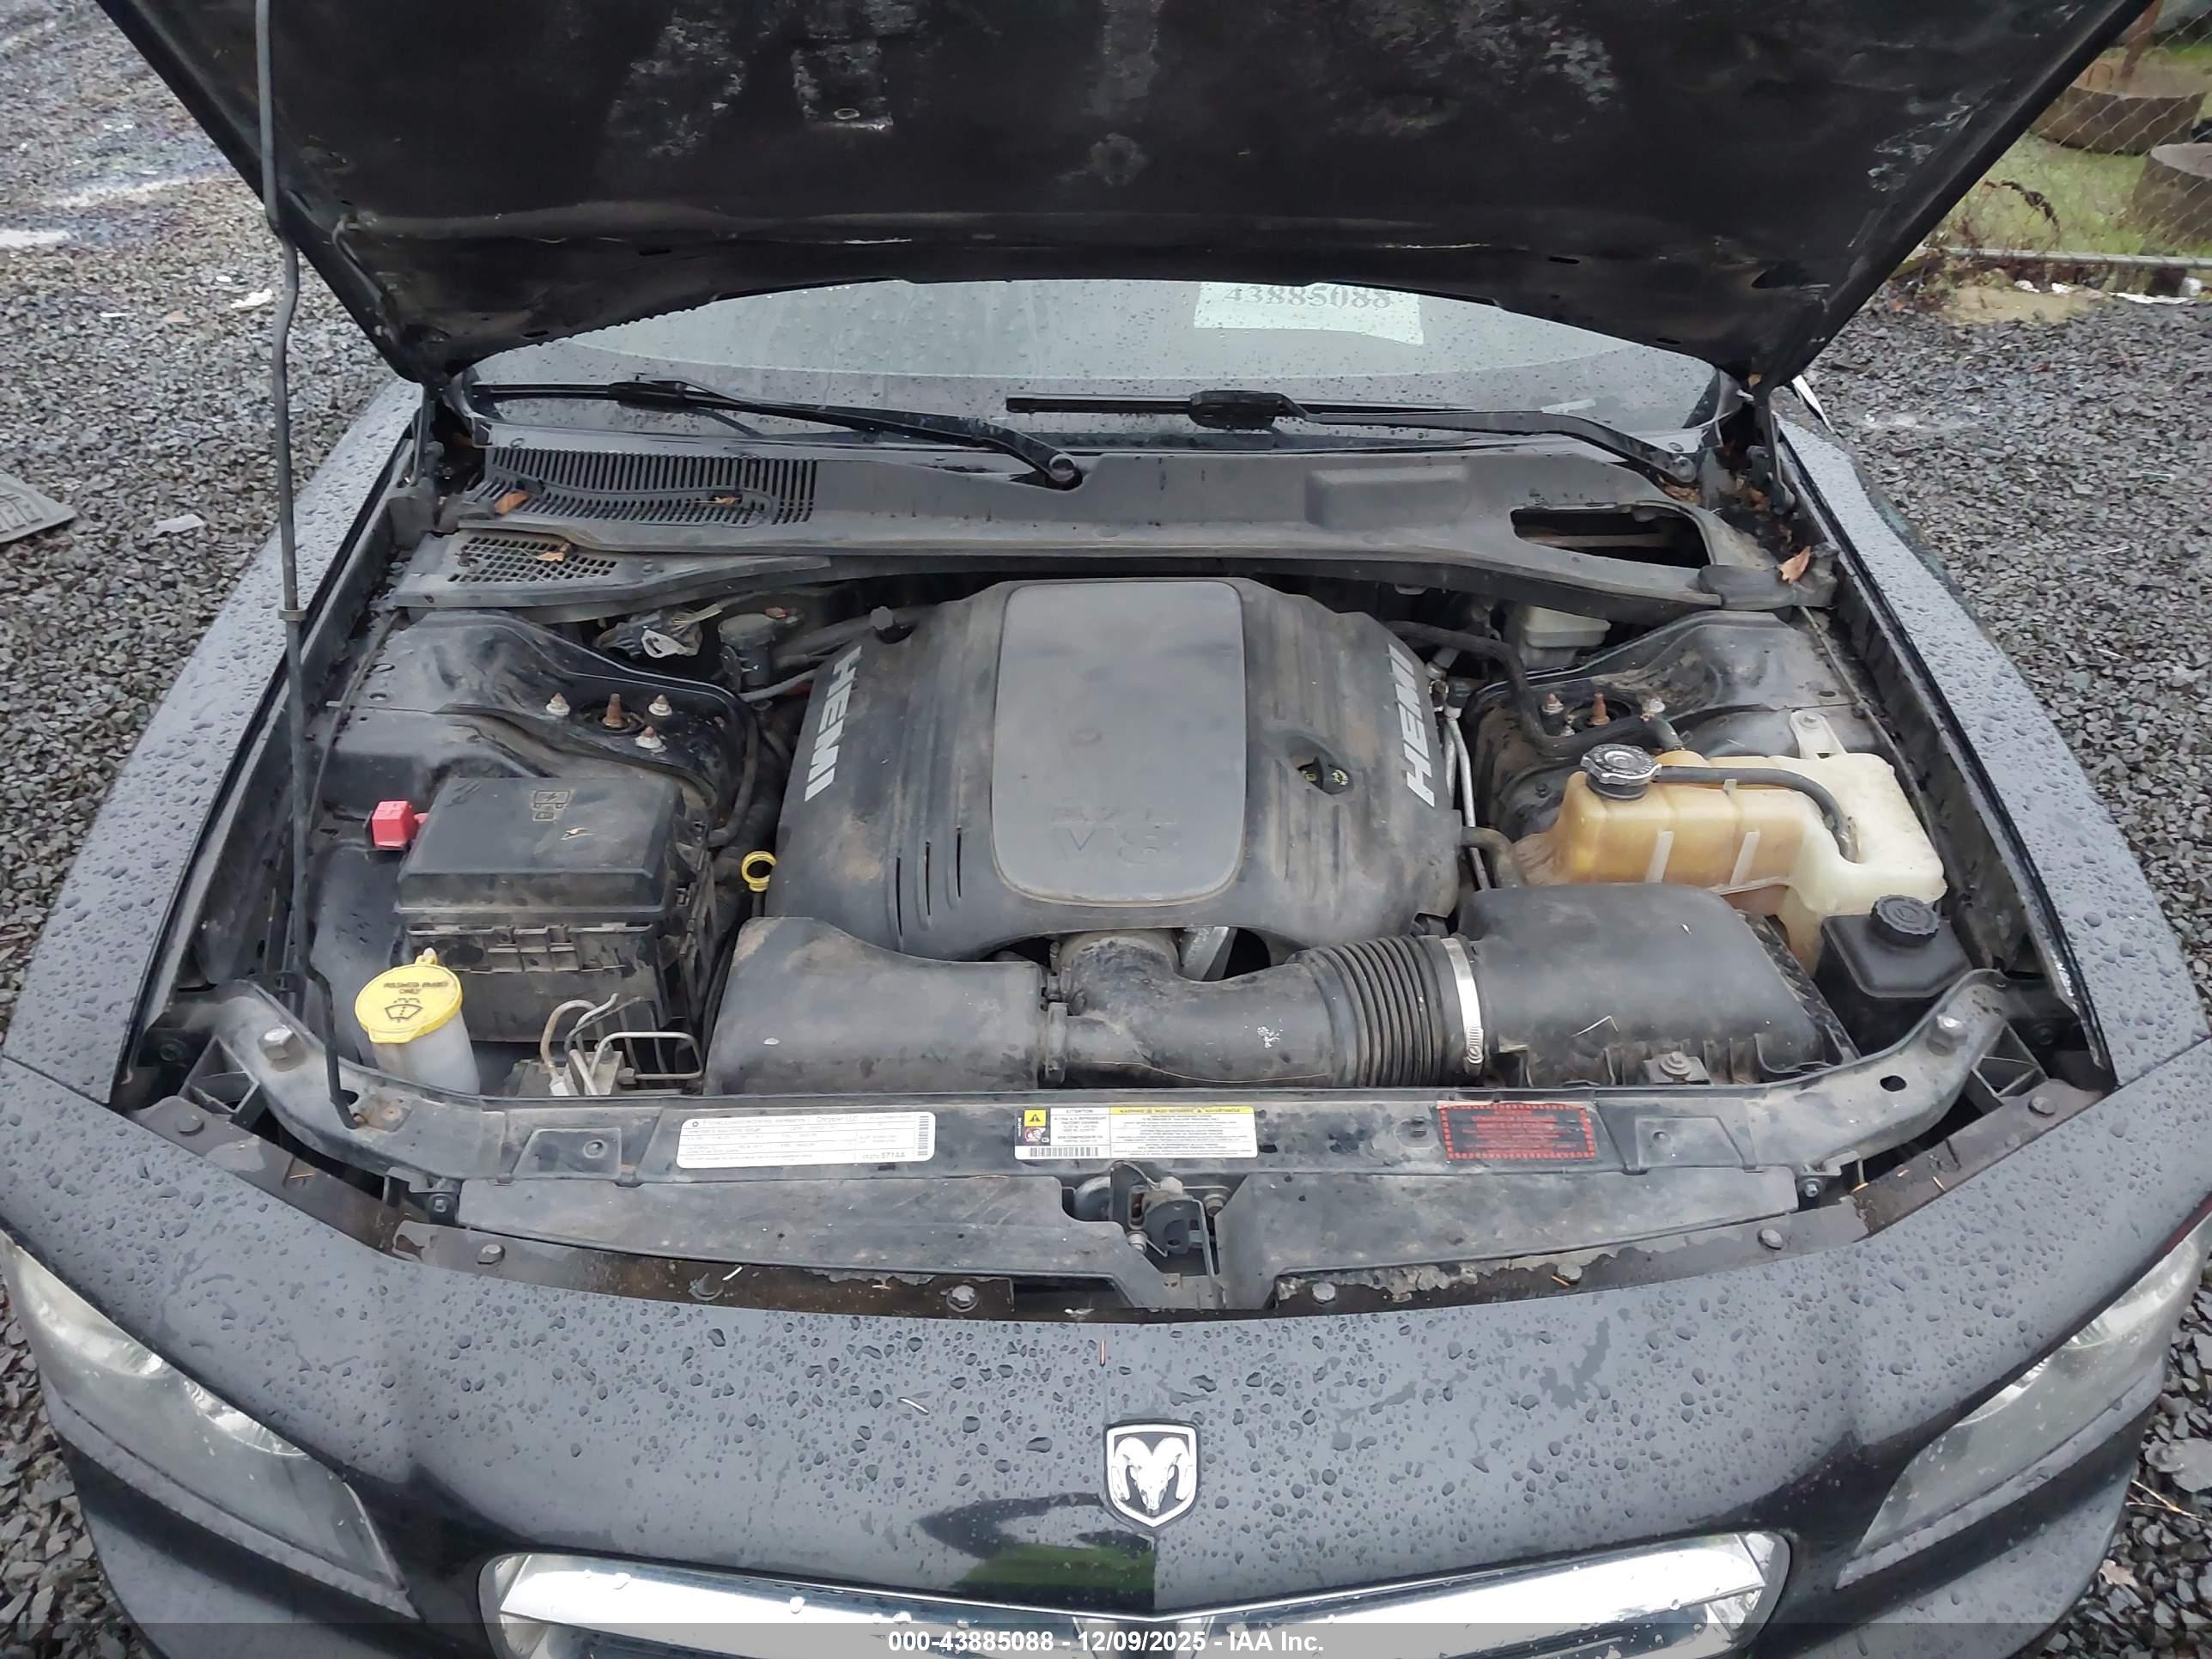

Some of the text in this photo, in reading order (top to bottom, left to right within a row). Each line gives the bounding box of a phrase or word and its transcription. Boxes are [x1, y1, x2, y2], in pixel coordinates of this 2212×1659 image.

[1223, 285, 1391, 309] 43885088
[805, 646, 862, 802] HEMI
[1389, 644, 1435, 807] HEMI
